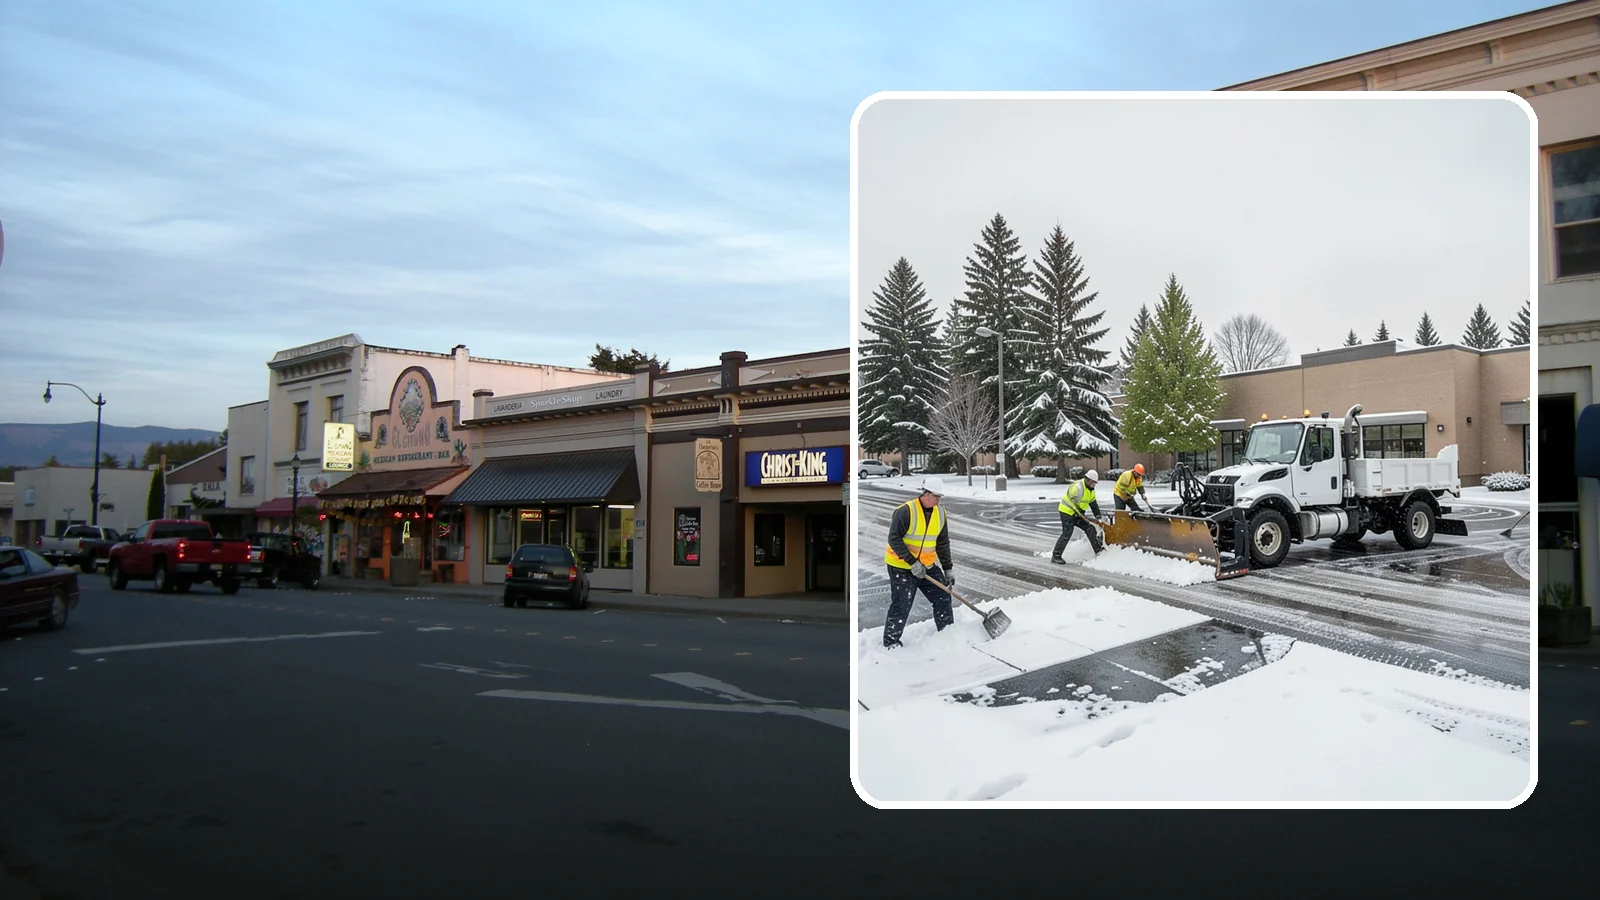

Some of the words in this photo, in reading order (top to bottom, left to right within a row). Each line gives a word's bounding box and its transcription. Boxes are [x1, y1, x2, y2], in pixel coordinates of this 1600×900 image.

[531, 398, 561, 409] Sparkle
[561, 393, 582, 405] Shop
[595, 389, 624, 400] LAUNDRY
[493, 402, 522, 412] LAVANDERIA
[374, 455, 396, 464] MEXICAN
[397, 451, 433, 463] RESTAURANT
[438, 450, 450, 459] BAR
[761, 452, 797, 478] CHRIST
[799, 450, 827, 476] KING
